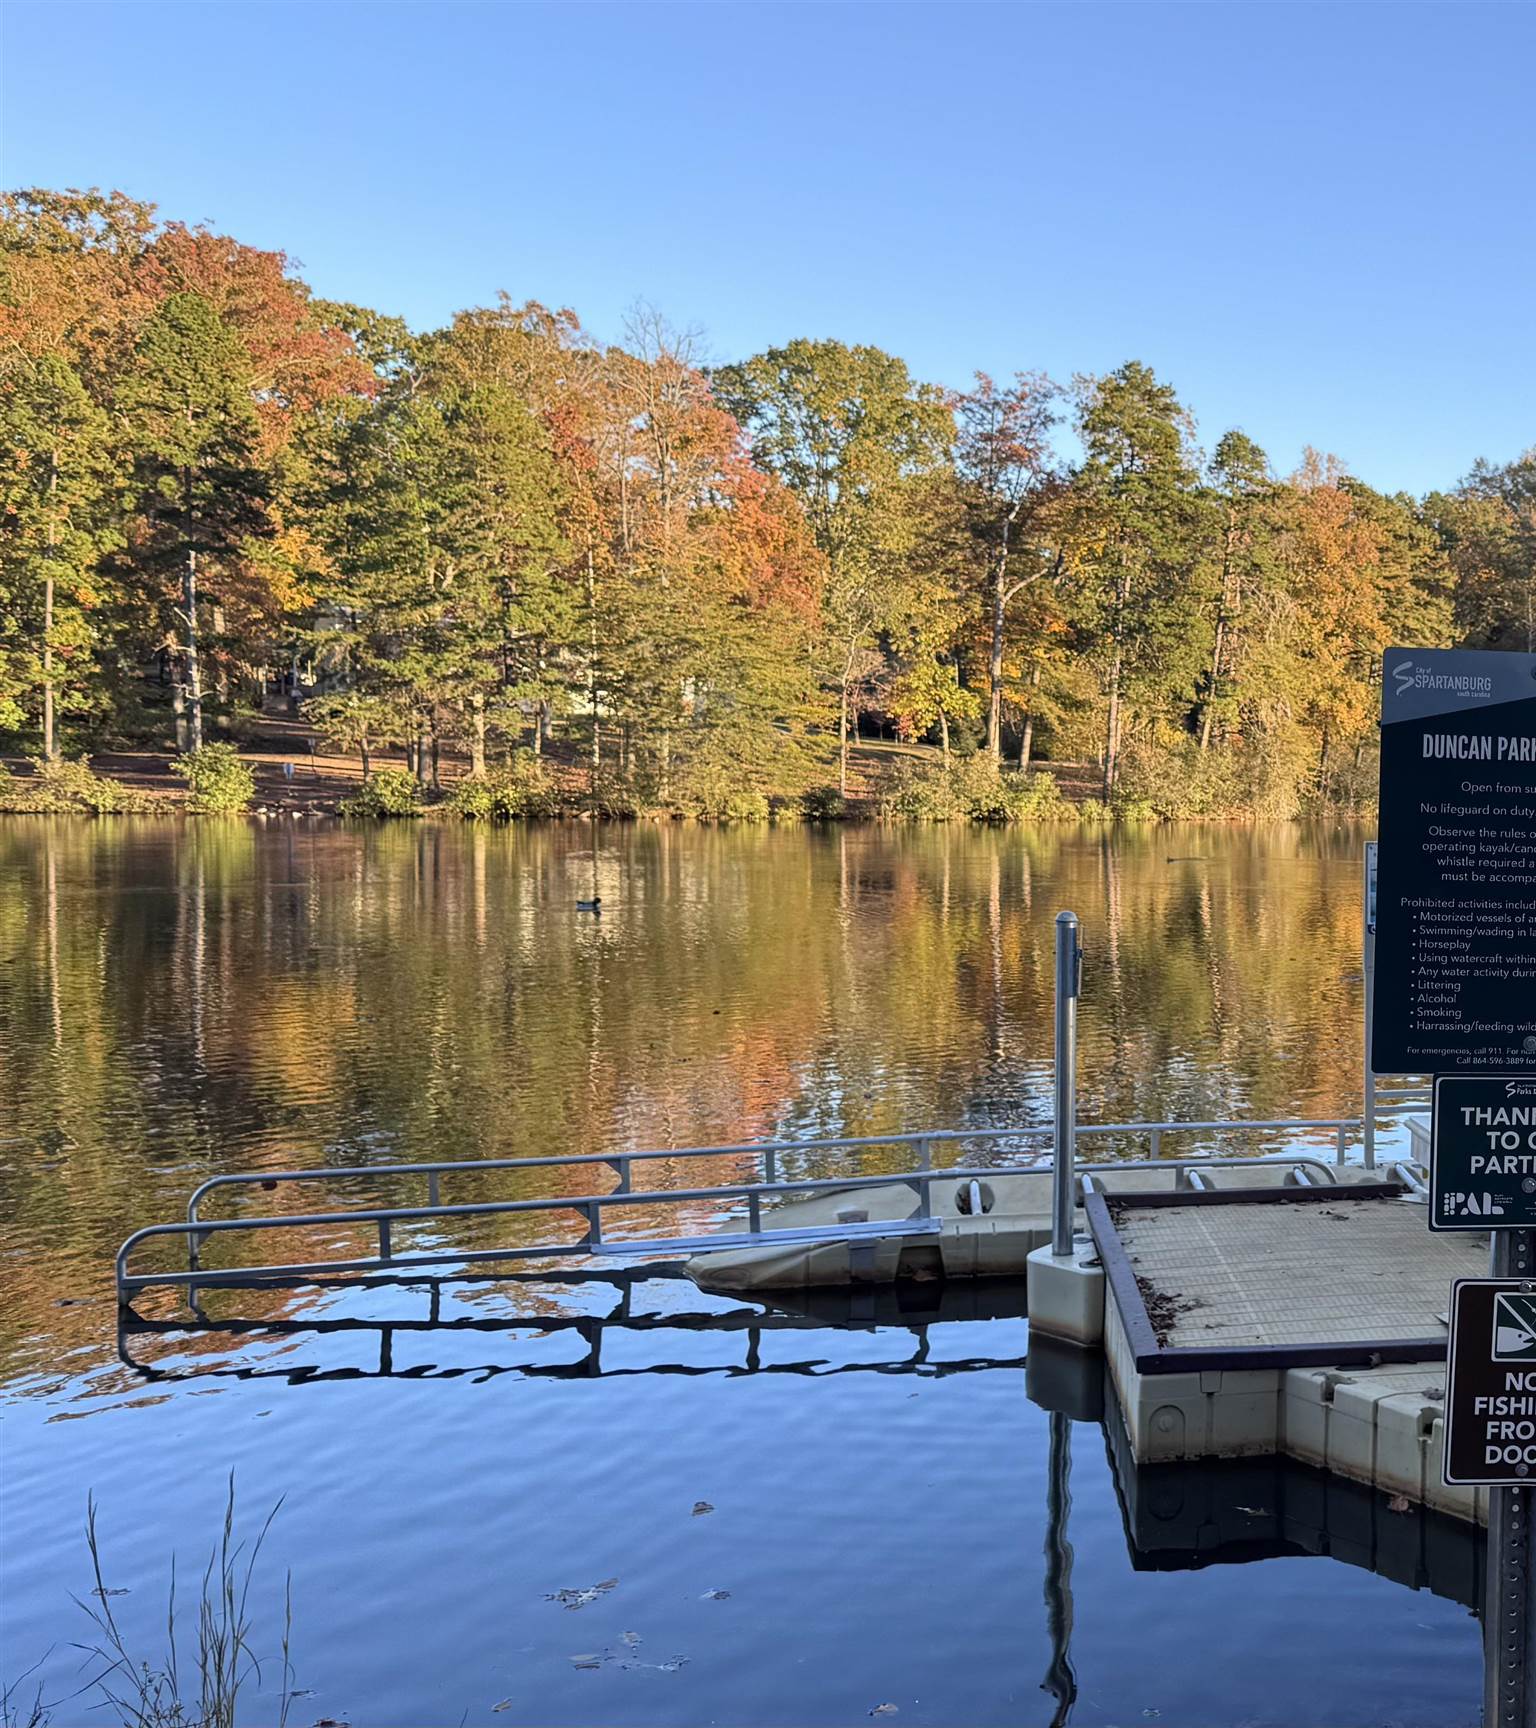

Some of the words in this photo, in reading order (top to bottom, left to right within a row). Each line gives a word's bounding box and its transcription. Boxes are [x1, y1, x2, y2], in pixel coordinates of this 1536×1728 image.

[1415, 674, 1491, 691] SPARTANBURG
[1423, 734, 1491, 759] DUNCAN
[1461, 781, 1492, 794] Open
[1496, 782, 1521, 792] from
[1421, 803, 1436, 813] No
[1441, 803, 1489, 816] lifeguard
[1510, 805, 1536, 818] duty.
[1428, 826, 1475, 836] Observe
[1479, 827, 1496, 837] the
[1500, 828, 1525, 838] rules
[1422, 843, 1475, 854] operating
[1437, 856, 1475, 866] whistle
[1478, 858, 1525, 868] required
[1471, 871, 1485, 881] be
[1401, 897, 1454, 907] Prohibited
[1458, 900, 1502, 910] activities
[1420, 913, 1473, 922] Motorized
[1476, 913, 1511, 922] vessels
[1514, 913, 1525, 922] of
[1419, 927, 1513, 938] Swimming/wading
[1517, 927, 1526, 936] in
[1419, 940, 1470, 951] Horseplay
[1419, 953, 1447, 964] Using
[1451, 953, 1501, 963] watercraft
[1505, 954, 1535, 963] within
[1418, 966, 1438, 978] Any
[1441, 968, 1469, 976] water
[1473, 968, 1509, 979] activity
[1418, 981, 1460, 992] Littering
[1417, 993, 1456, 1002] Alcohol
[1417, 1006, 1461, 1019] Smoking
[1417, 1020, 1513, 1033] Harrassing/feeding
[1486, 1131, 1519, 1149] TO
